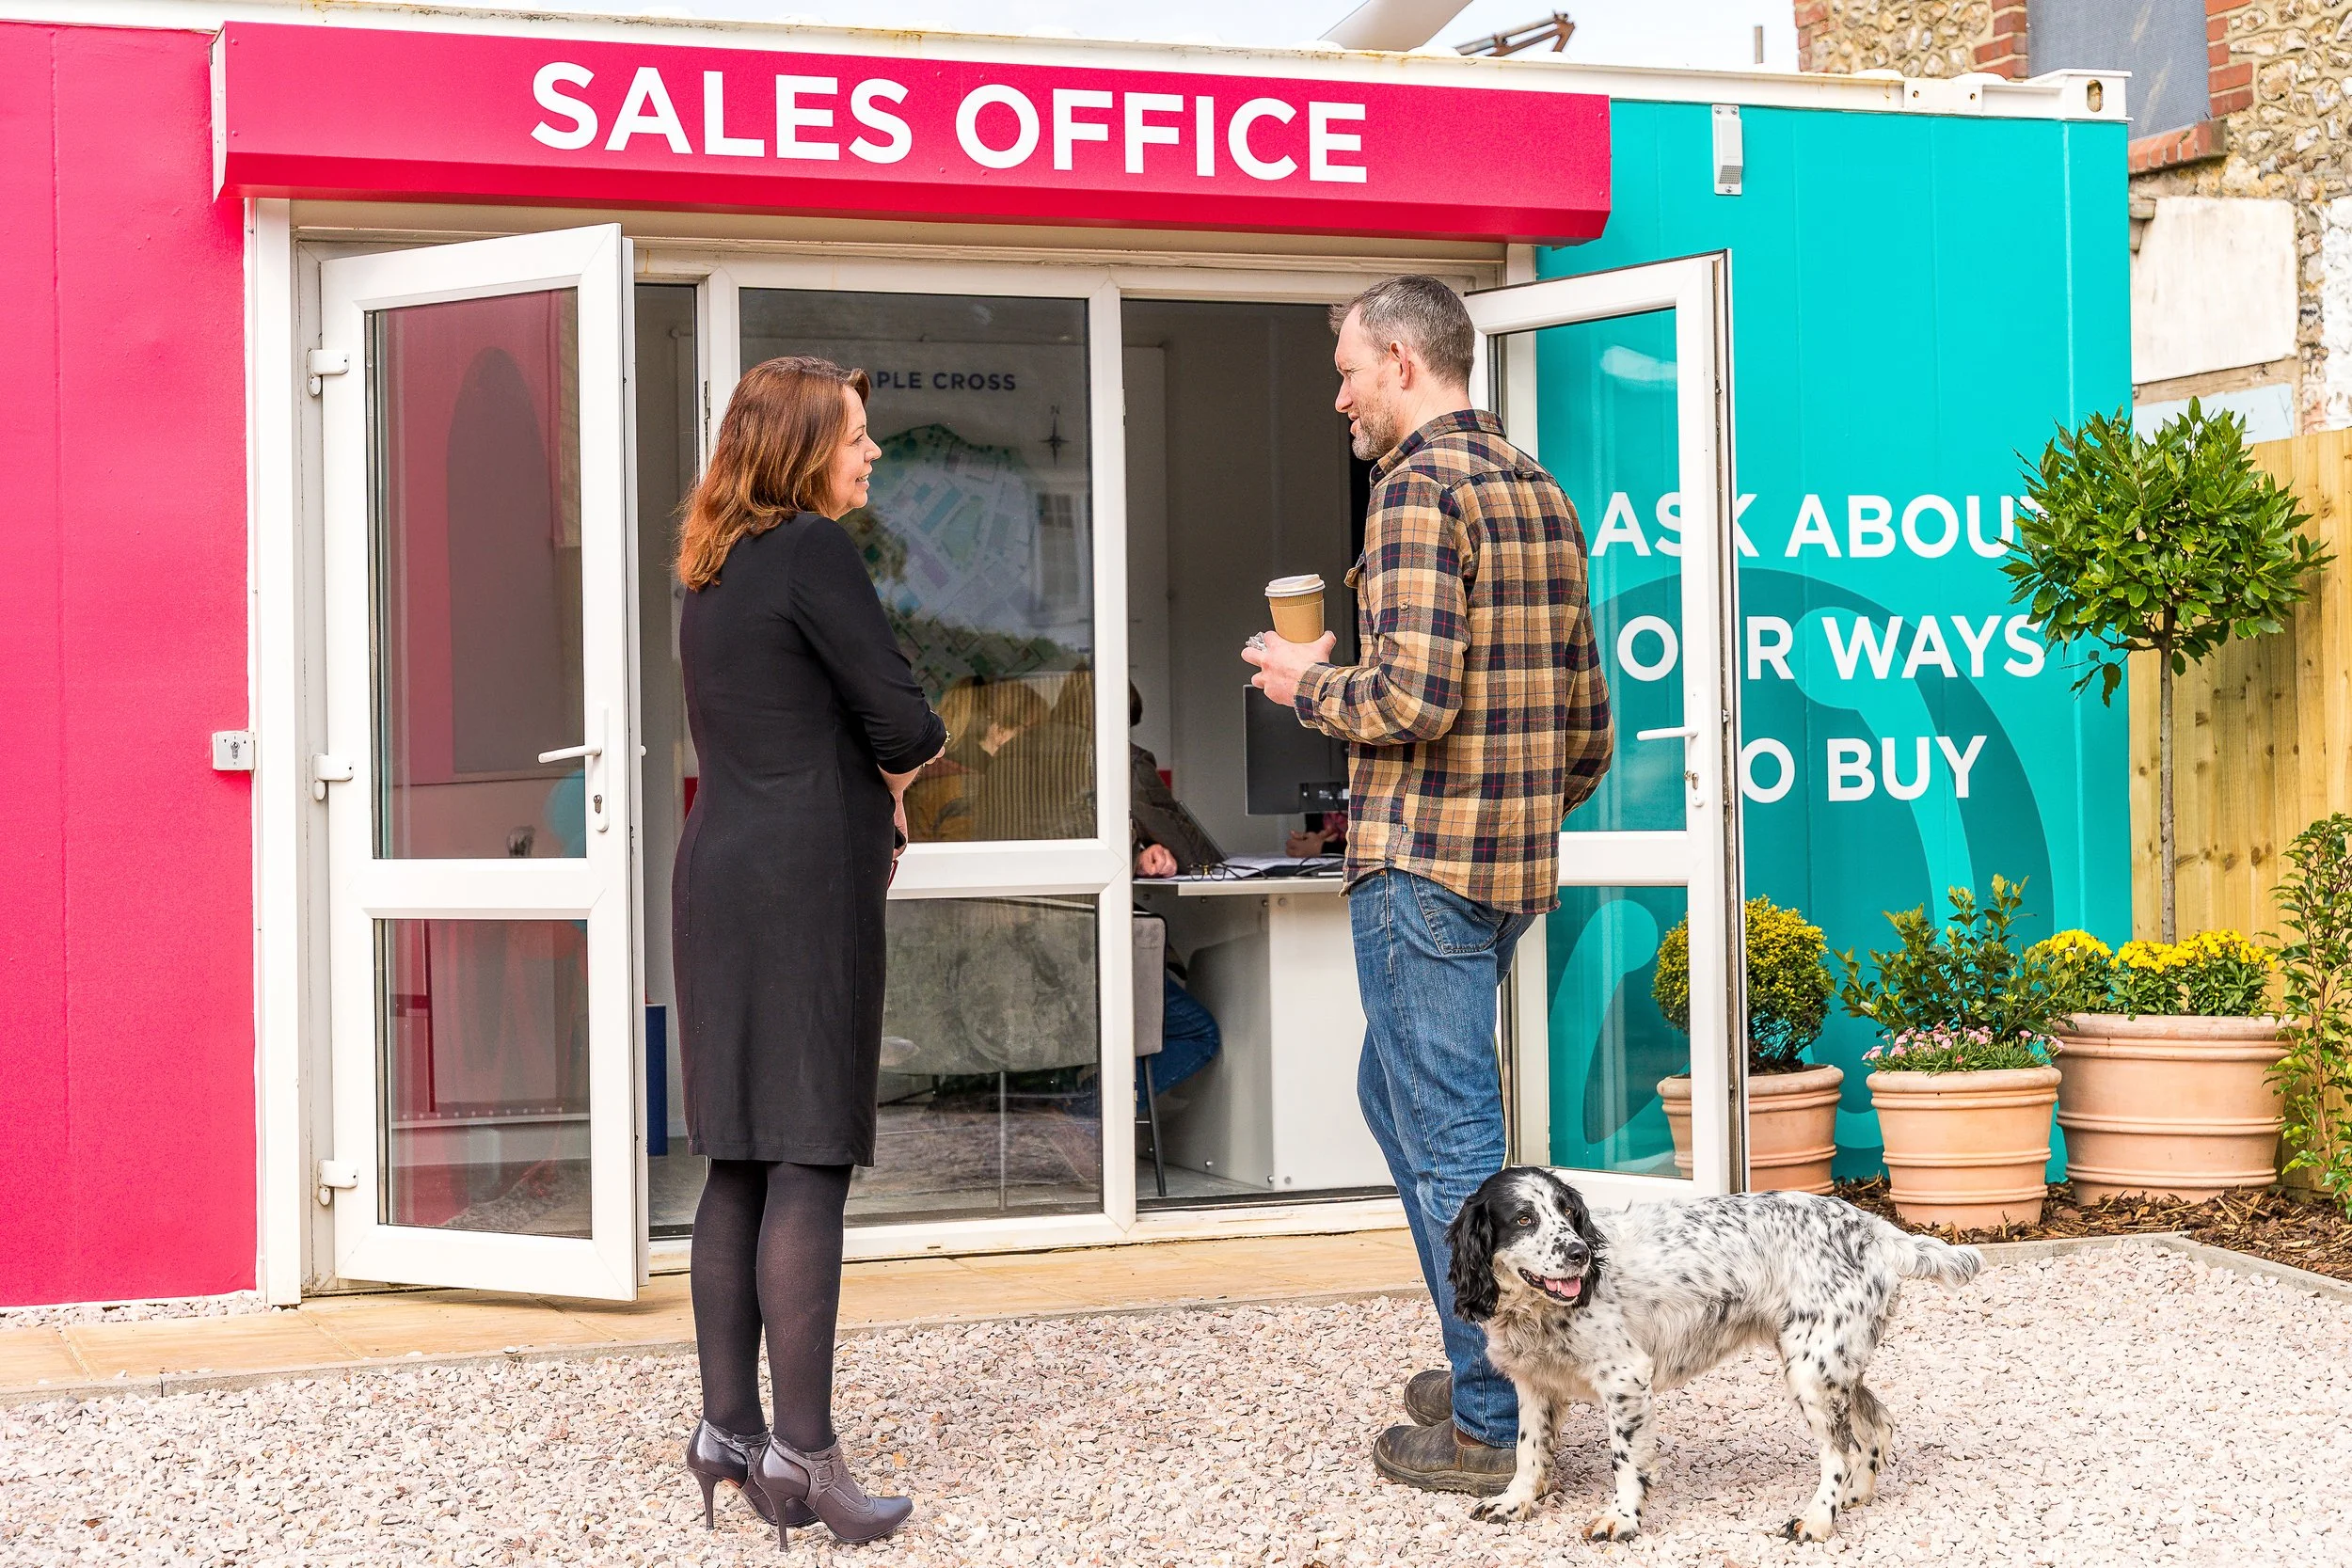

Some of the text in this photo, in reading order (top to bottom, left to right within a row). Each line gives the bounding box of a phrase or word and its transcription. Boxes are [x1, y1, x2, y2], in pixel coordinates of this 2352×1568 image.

[530, 61, 1368, 183] SALES OFFICE
[869, 371, 1016, 390] PLE CROSS
[1615, 614, 2046, 681] OR WAYS
[1827, 736, 1988, 802] BUY
